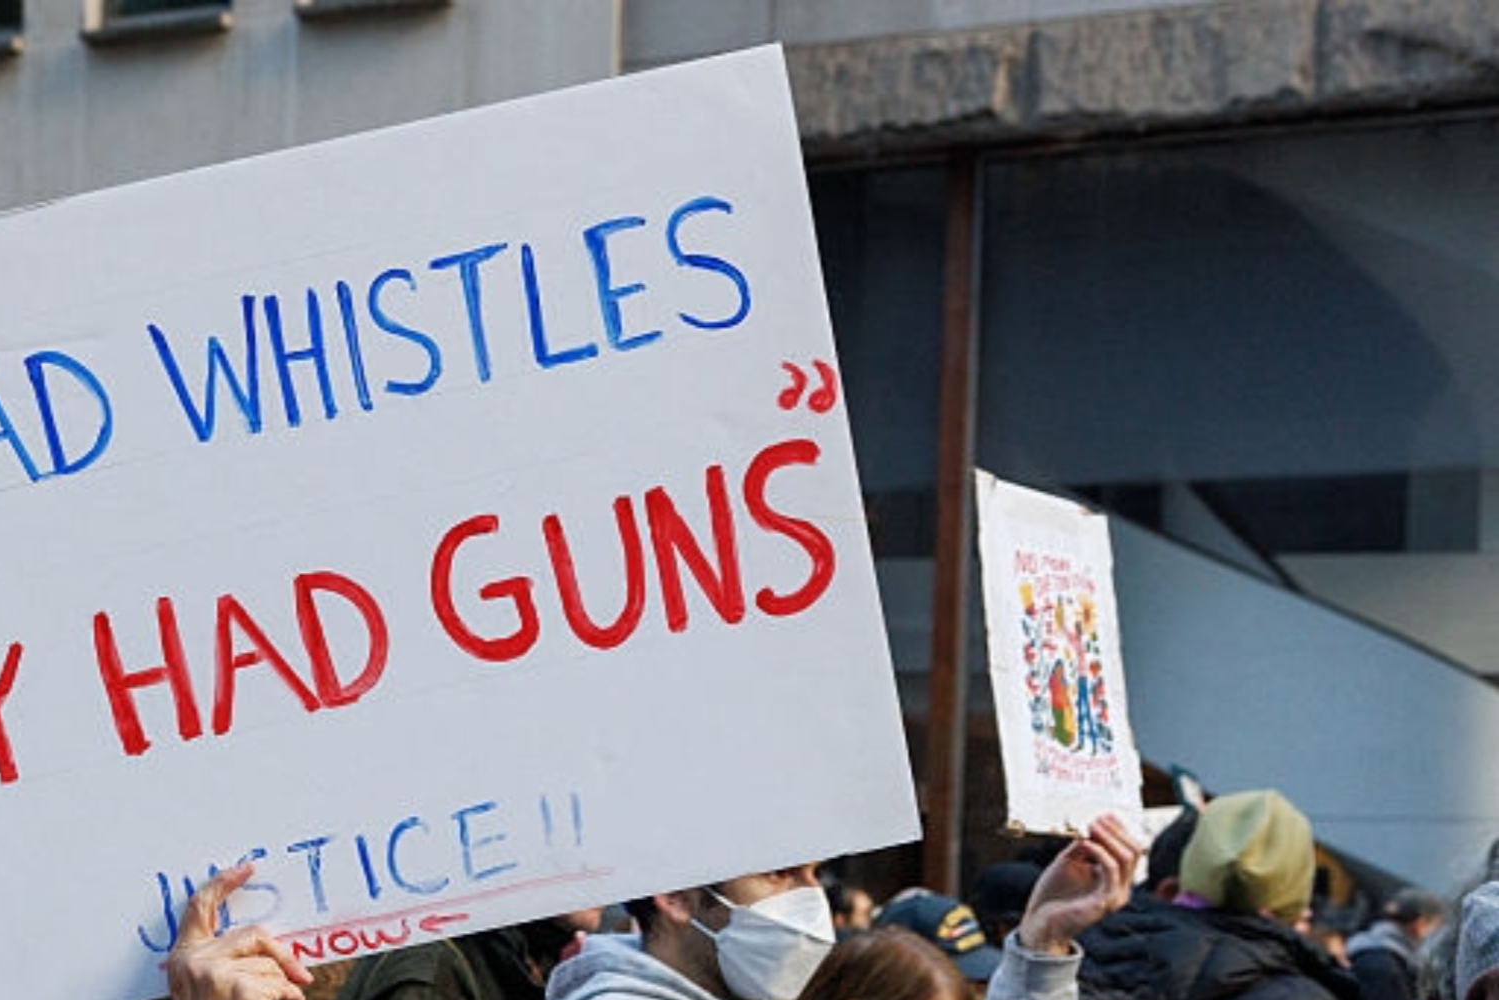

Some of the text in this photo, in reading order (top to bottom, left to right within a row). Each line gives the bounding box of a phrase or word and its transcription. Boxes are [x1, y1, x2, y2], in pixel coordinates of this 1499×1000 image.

[147, 196, 751, 443] WHISTLES
[93, 571, 389, 755] HAD
[292, 918, 411, 960] NOW
